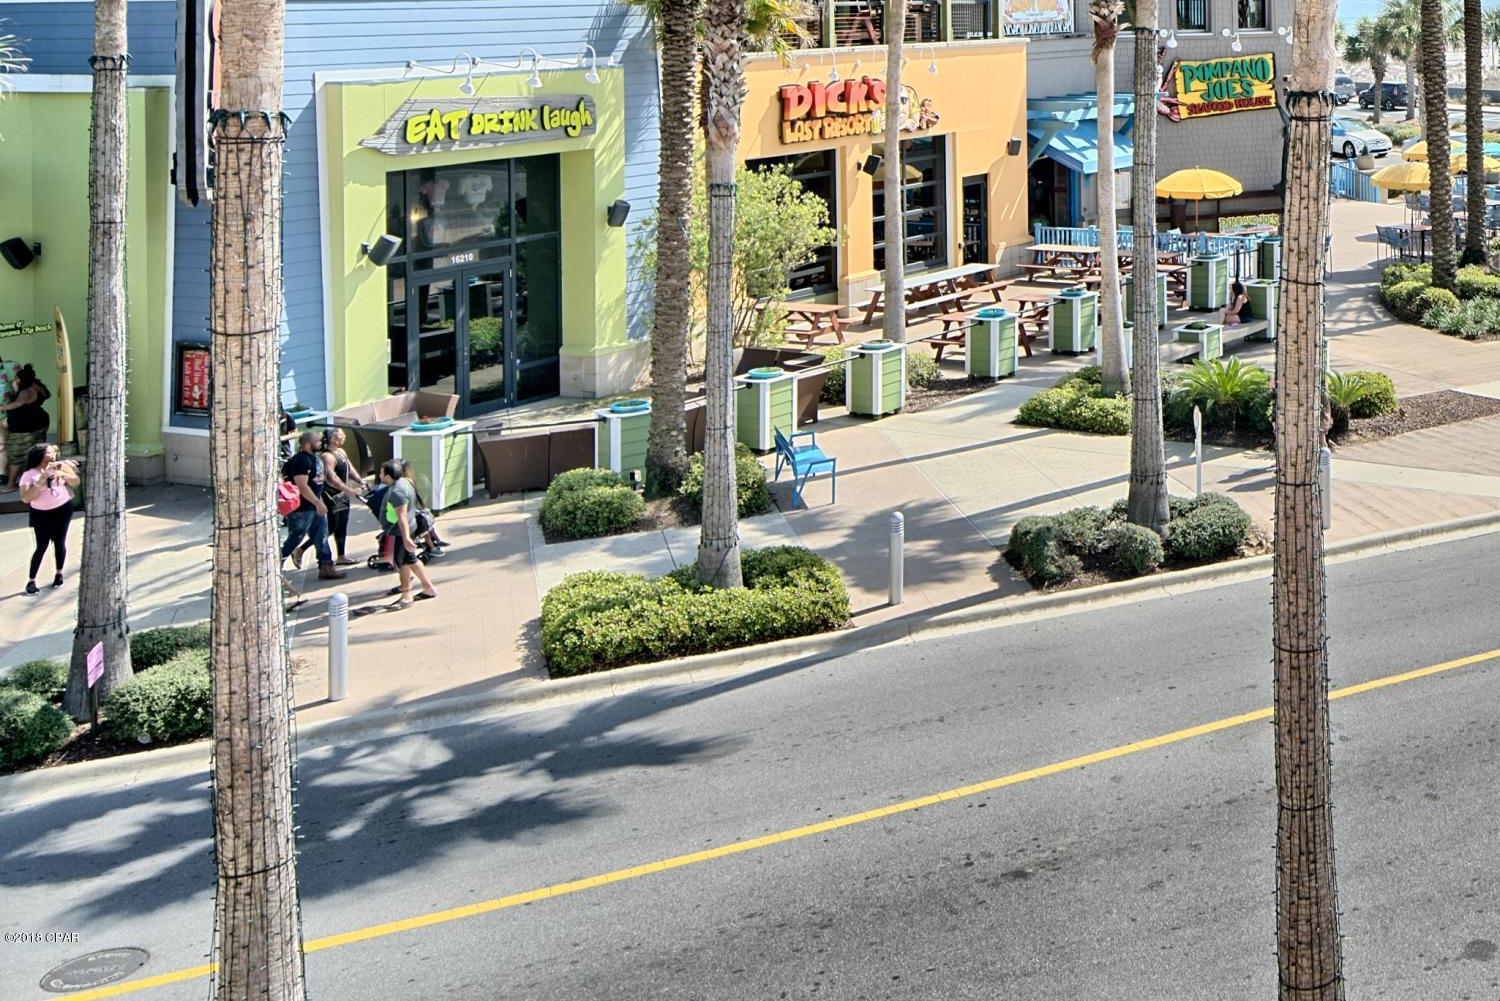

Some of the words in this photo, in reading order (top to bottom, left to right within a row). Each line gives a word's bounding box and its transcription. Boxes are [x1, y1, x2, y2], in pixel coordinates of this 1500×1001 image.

[1180, 57, 1271, 94] POMPANO
[780, 76, 887, 121] DICK'S
[1187, 101, 1234, 115] SEAFOOD
[1234, 95, 1273, 109] HOUSE
[405, 108, 468, 146] EAT
[469, 107, 540, 135] DRINK
[542, 97, 594, 138] laugh
[783, 117, 822, 144] LAST
[822, 114, 873, 140] RESORT
[451, 253, 473, 264] 16210
[0, 330, 20, 338] anama
[35, 324, 52, 332] Beach
